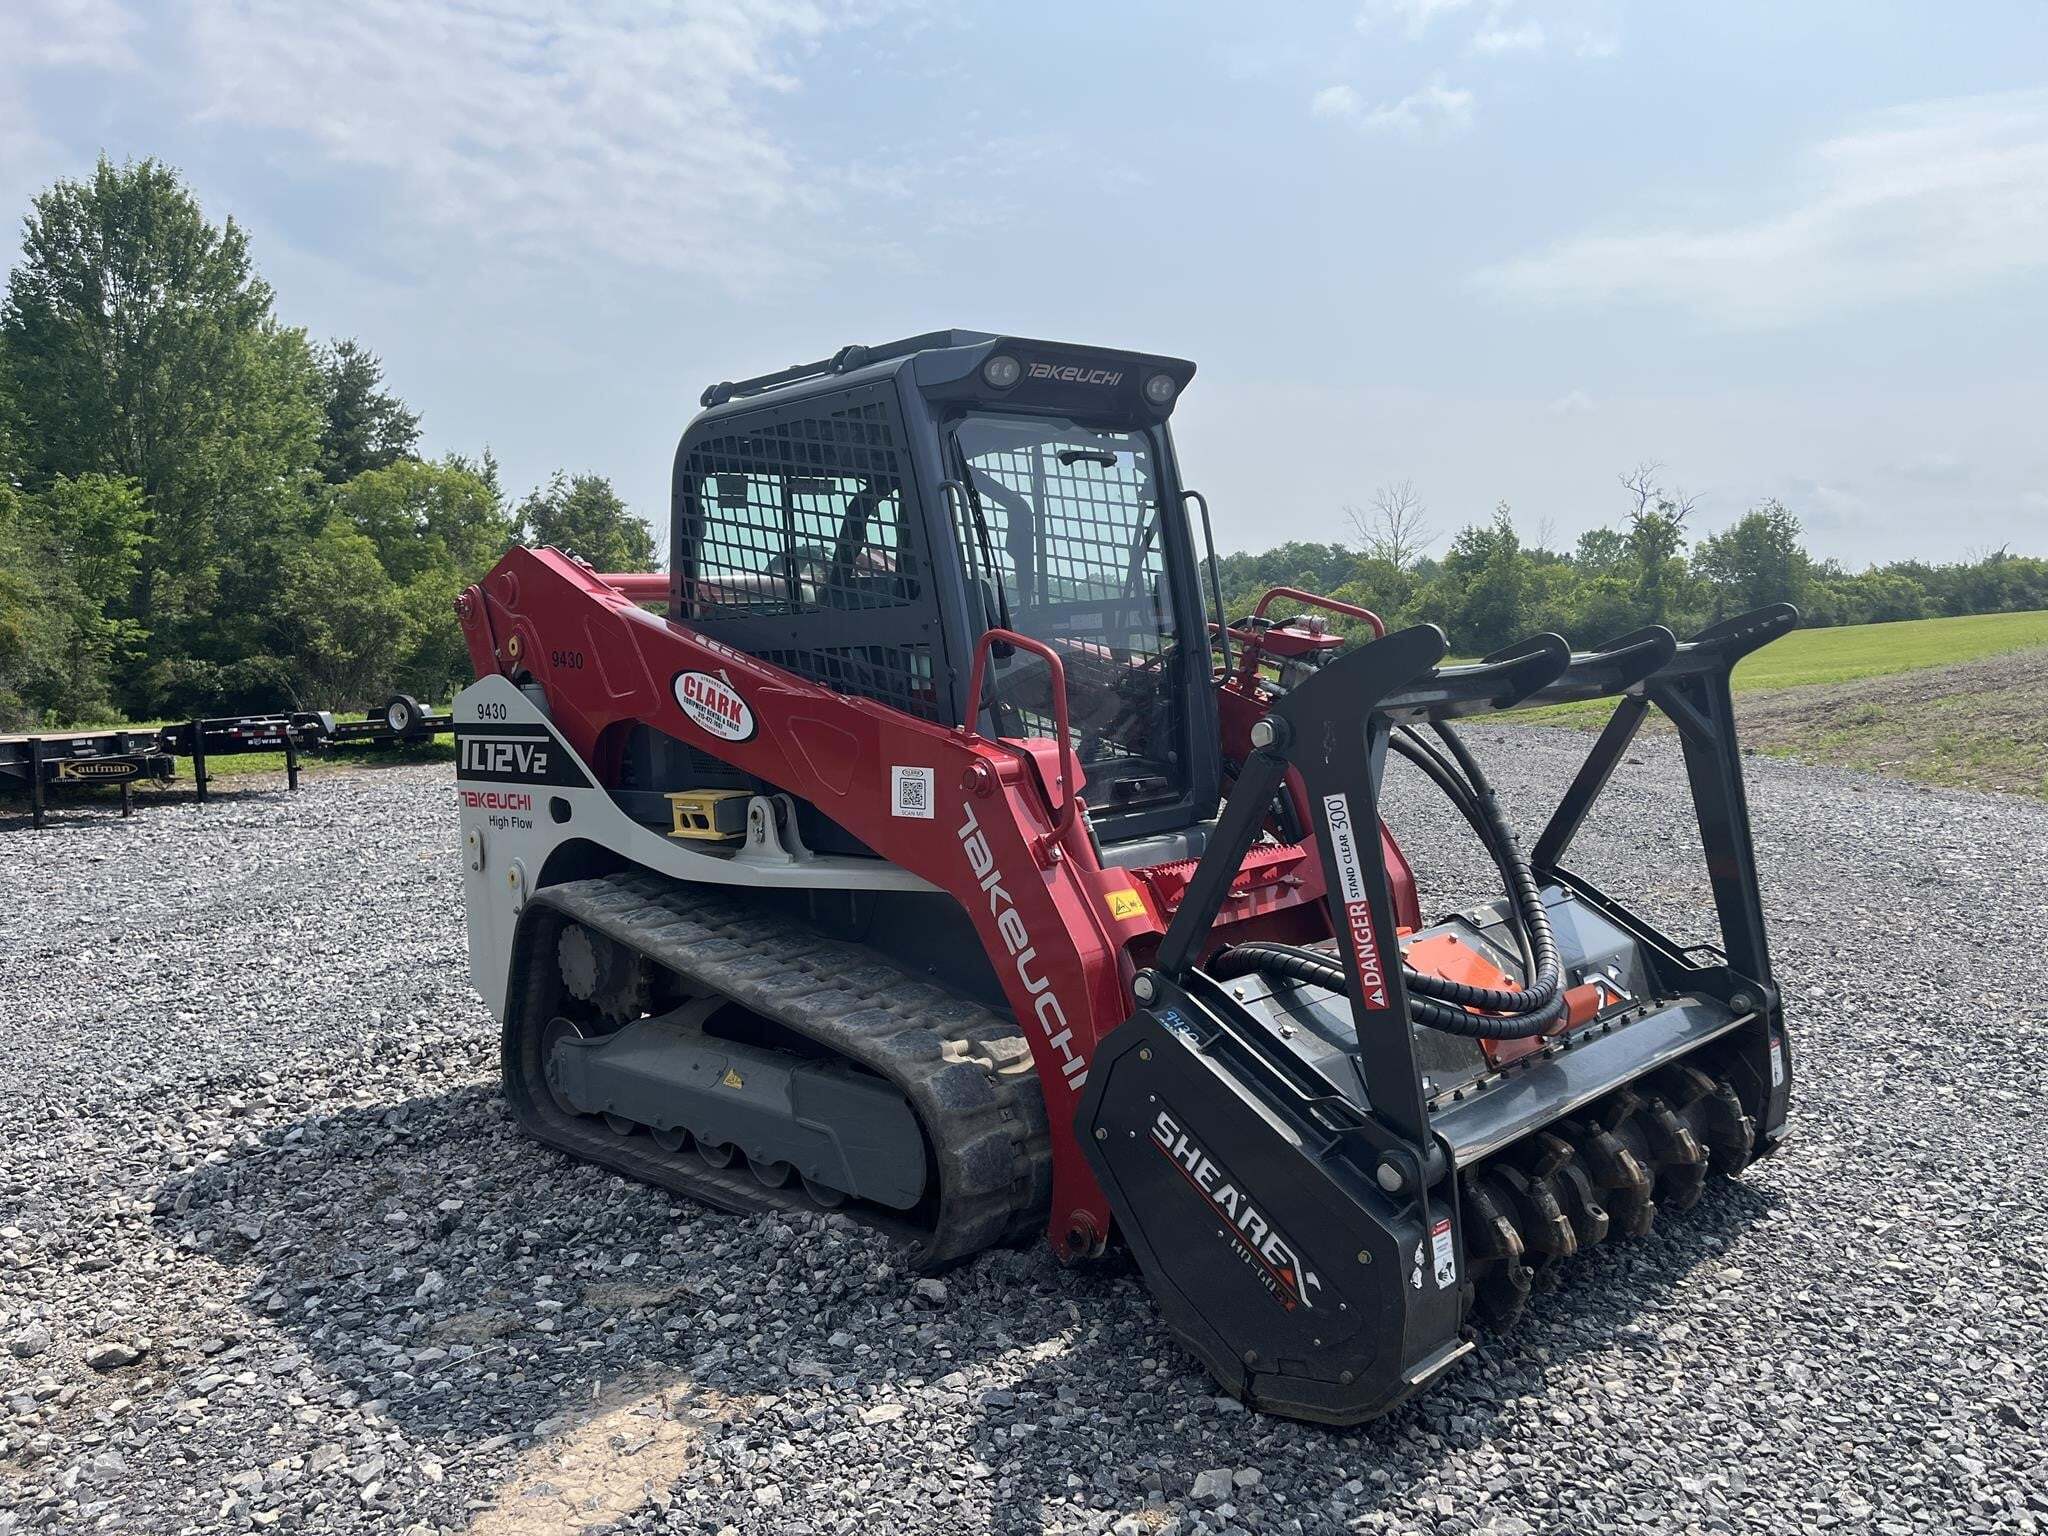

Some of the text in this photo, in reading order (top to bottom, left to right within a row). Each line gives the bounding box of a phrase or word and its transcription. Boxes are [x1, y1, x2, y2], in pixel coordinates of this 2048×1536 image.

[551, 650, 584, 670] 9430
[477, 703, 507, 720] 9430
[683, 695, 707, 714] EQUIPMENT
[684, 675, 744, 725] CLARK
[457, 734, 550, 774] TL12V2
[56, 761, 131, 779] Kaufman
[489, 815, 533, 830] High Flow
[1338, 833, 1354, 865] CLEAR
[1345, 866, 1360, 899] STAND
[1349, 903, 1384, 987] DANGER
